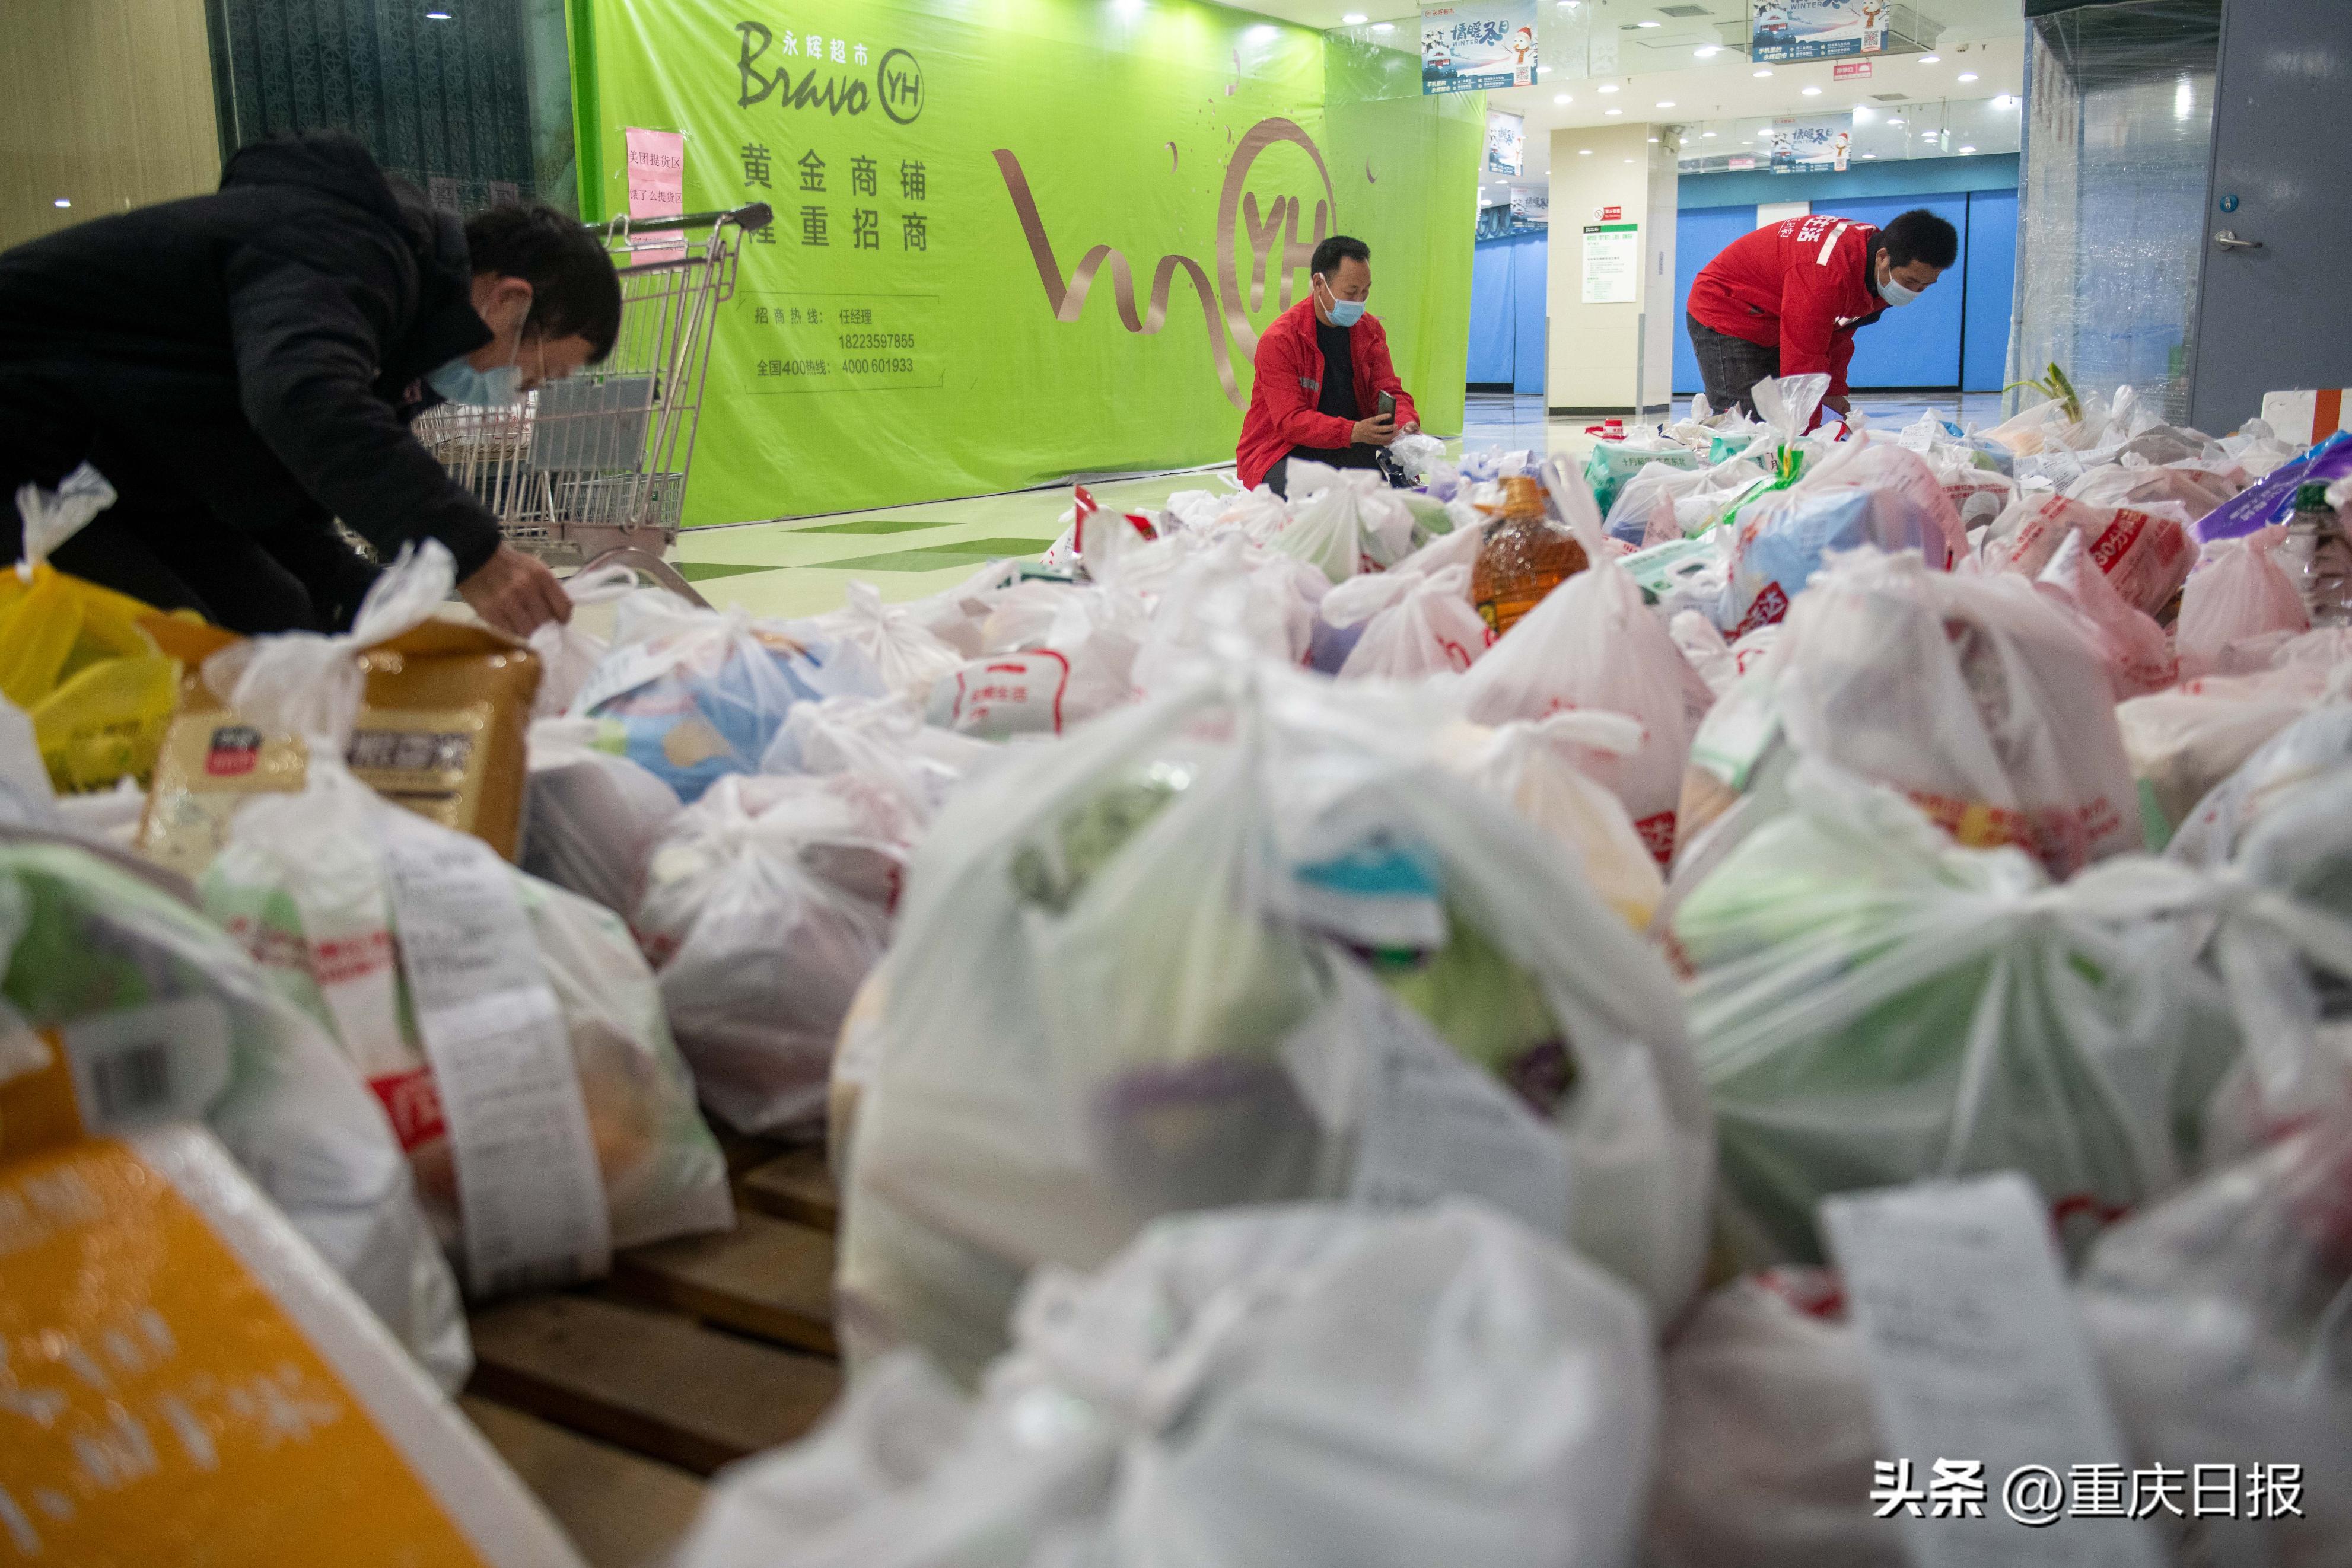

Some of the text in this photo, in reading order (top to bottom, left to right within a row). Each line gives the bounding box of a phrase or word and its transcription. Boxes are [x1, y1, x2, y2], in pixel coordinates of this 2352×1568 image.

[1432, 8, 1455, 17] 永辉超市
[1790, 2, 1823, 10] WINTER
[1450, 20, 1510, 46] 情暖冬日
[782, 30, 868, 67] 永辉超市
[735, 21, 919, 117] Bravo YH
[628, 150, 681, 169] 美团提货区
[741, 142, 926, 200] 黄金商铺
[629, 189, 682, 203] 饿了么提货区
[839, 308, 872, 325] 任经理
[839, 334, 914, 349] 18223597855
[842, 359, 868, 374] 4000
[871, 358, 914, 373] 601933
